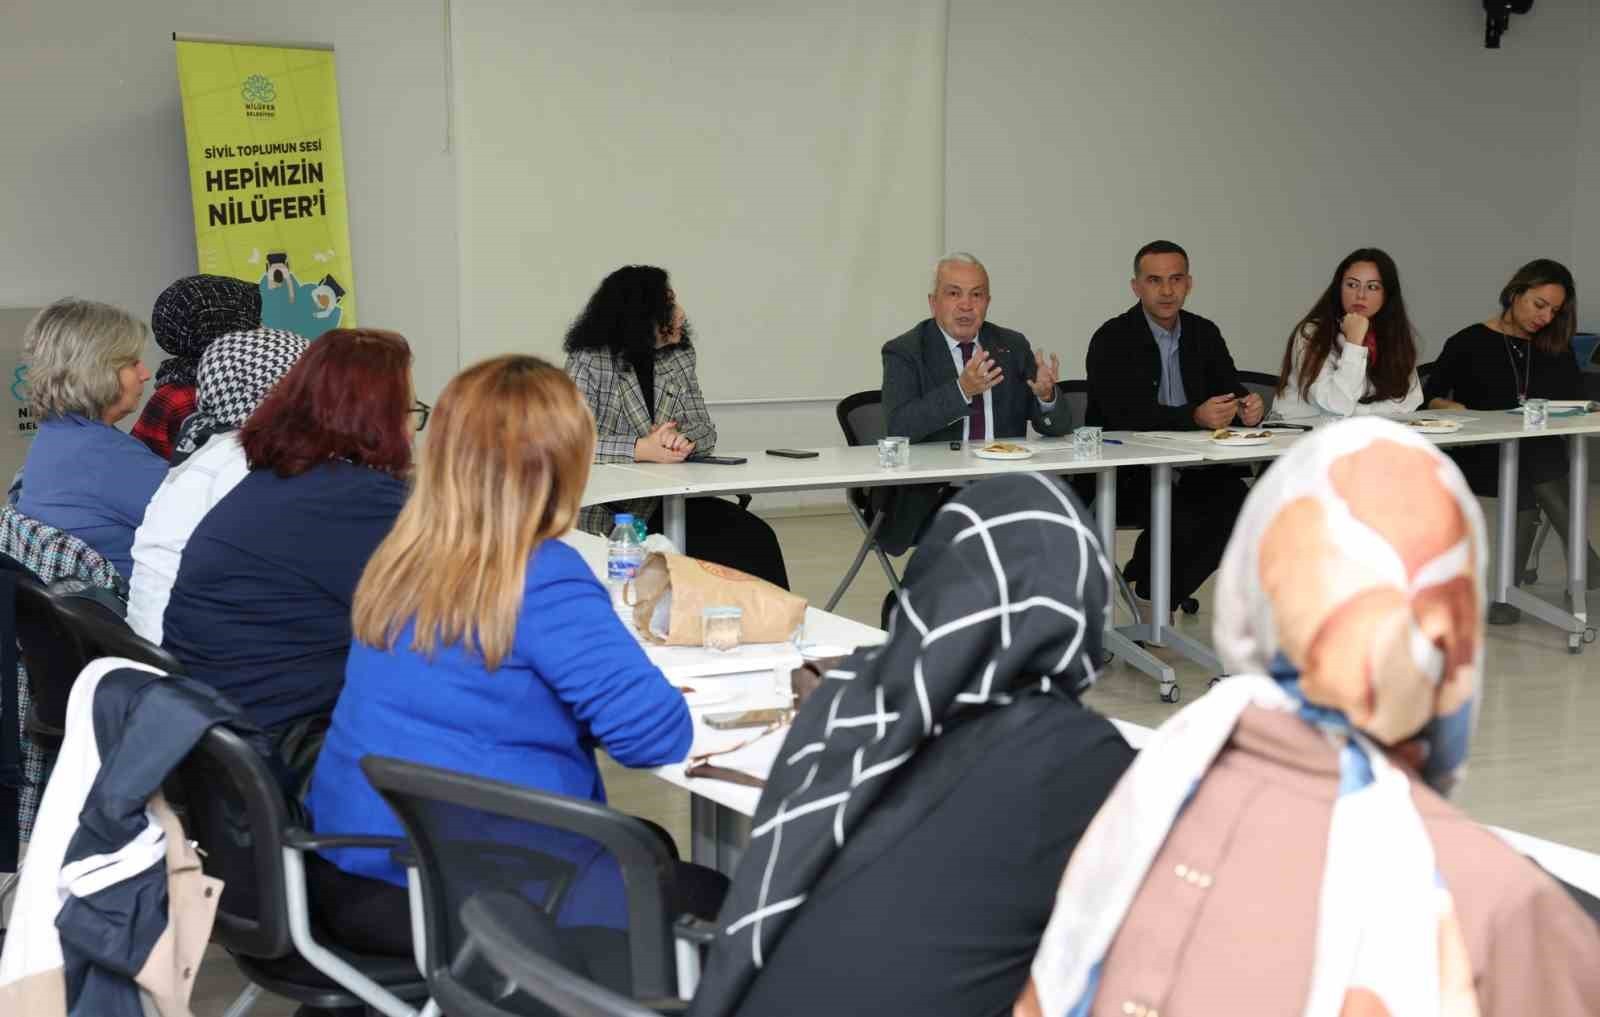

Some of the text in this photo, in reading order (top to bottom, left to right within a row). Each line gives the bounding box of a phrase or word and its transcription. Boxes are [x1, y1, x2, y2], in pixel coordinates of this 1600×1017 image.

[205, 138, 322, 159] SİVİL TOPLUMUN SESİ
[206, 159, 324, 192] HEPİMİZİN
